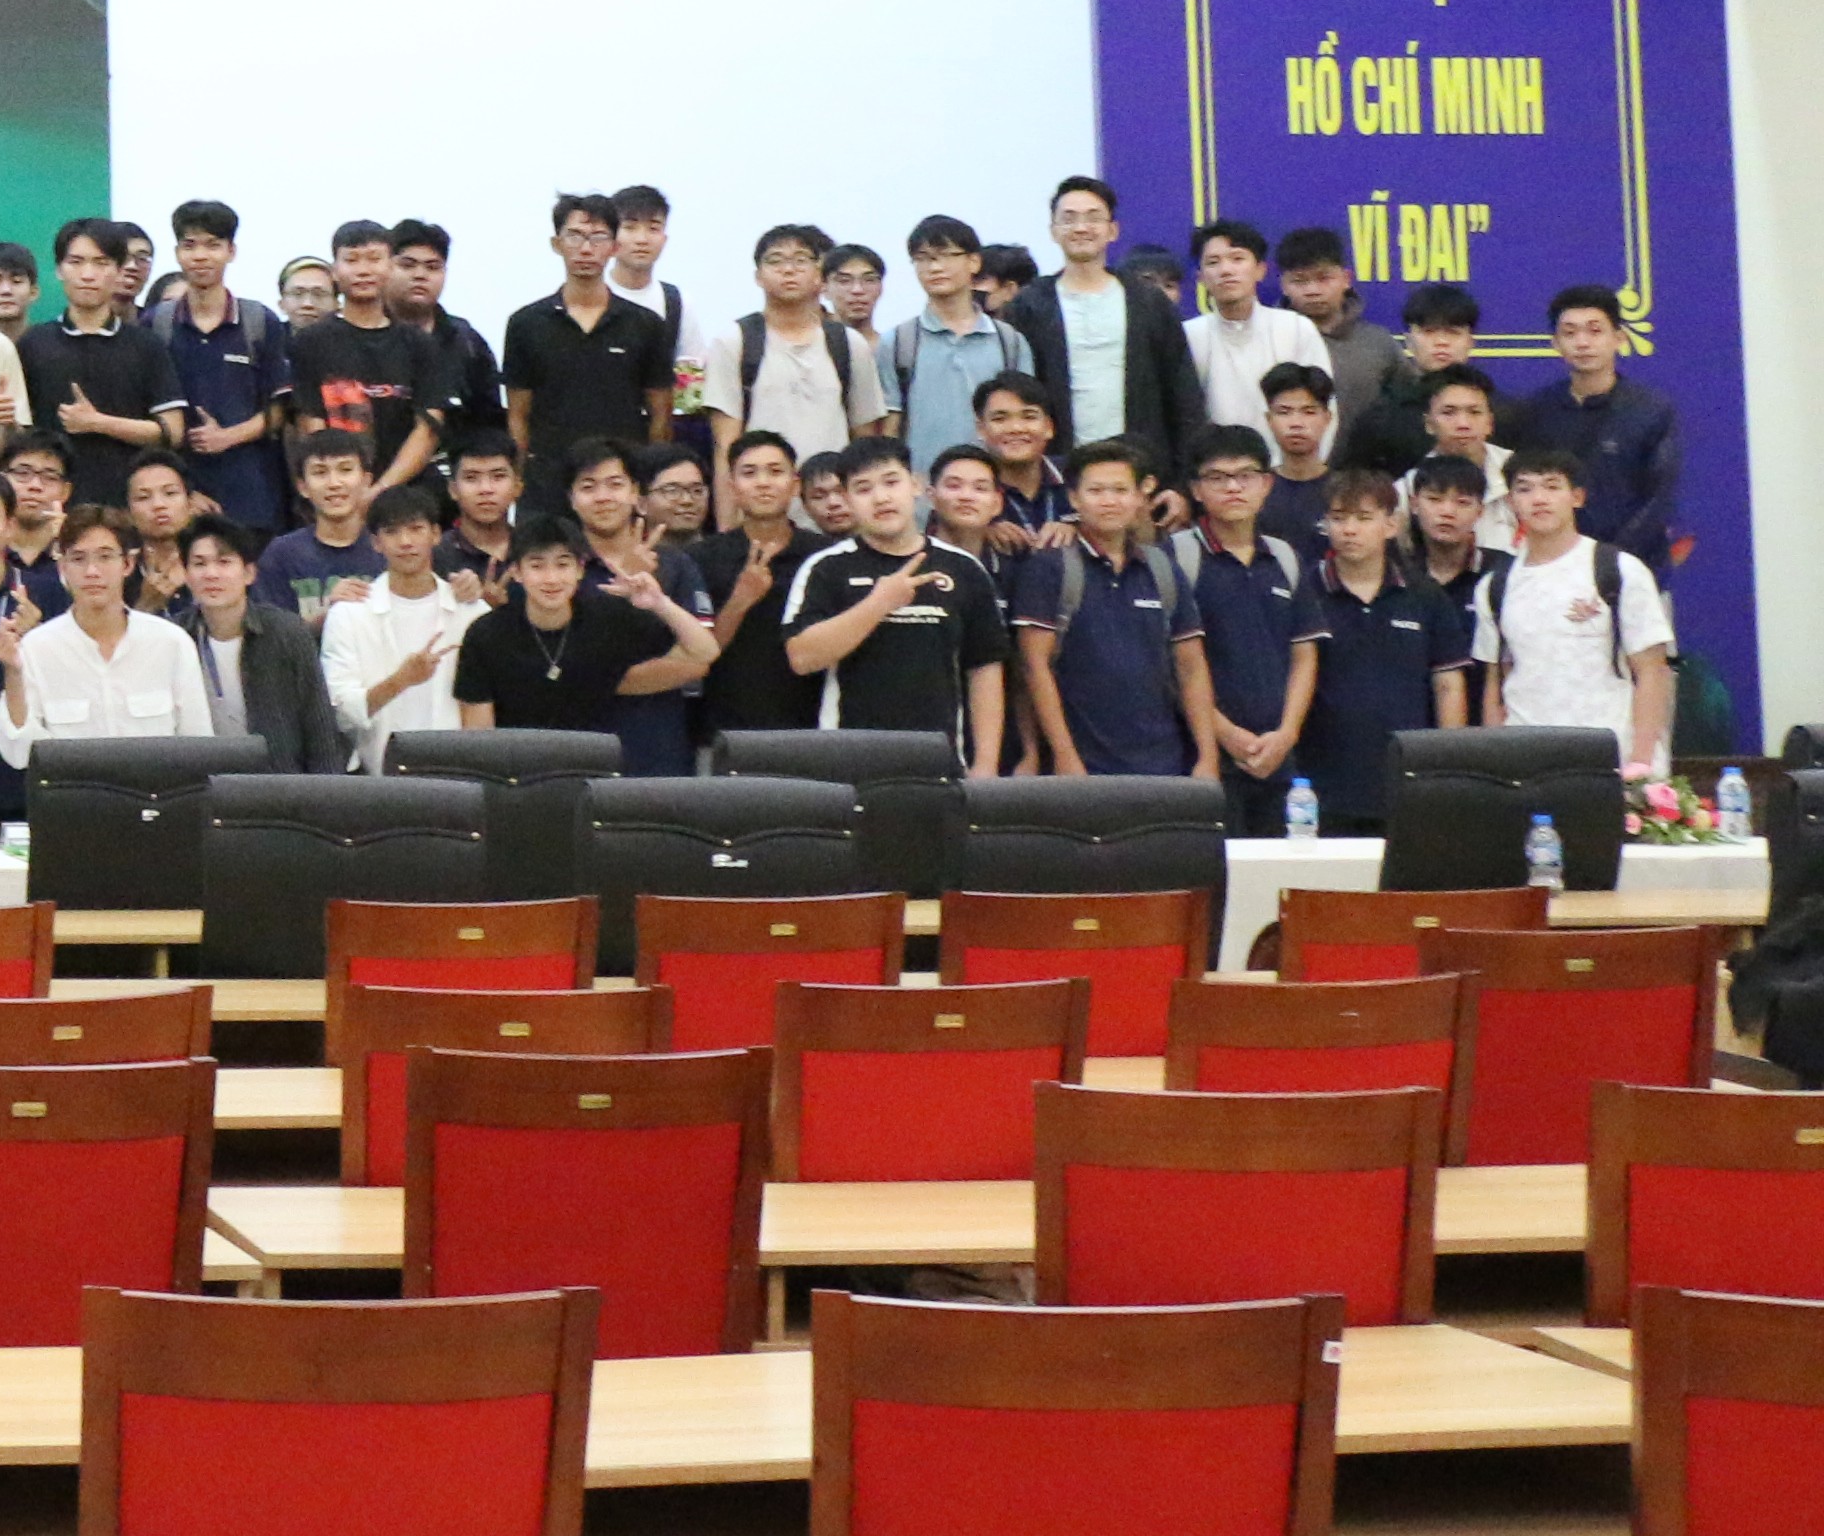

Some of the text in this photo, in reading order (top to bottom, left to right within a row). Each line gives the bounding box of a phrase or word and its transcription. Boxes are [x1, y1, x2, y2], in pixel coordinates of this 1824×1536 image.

[1287, 32, 1544, 134] HỒ CHÍ MINH
[1348, 189, 1390, 282] VĨ
